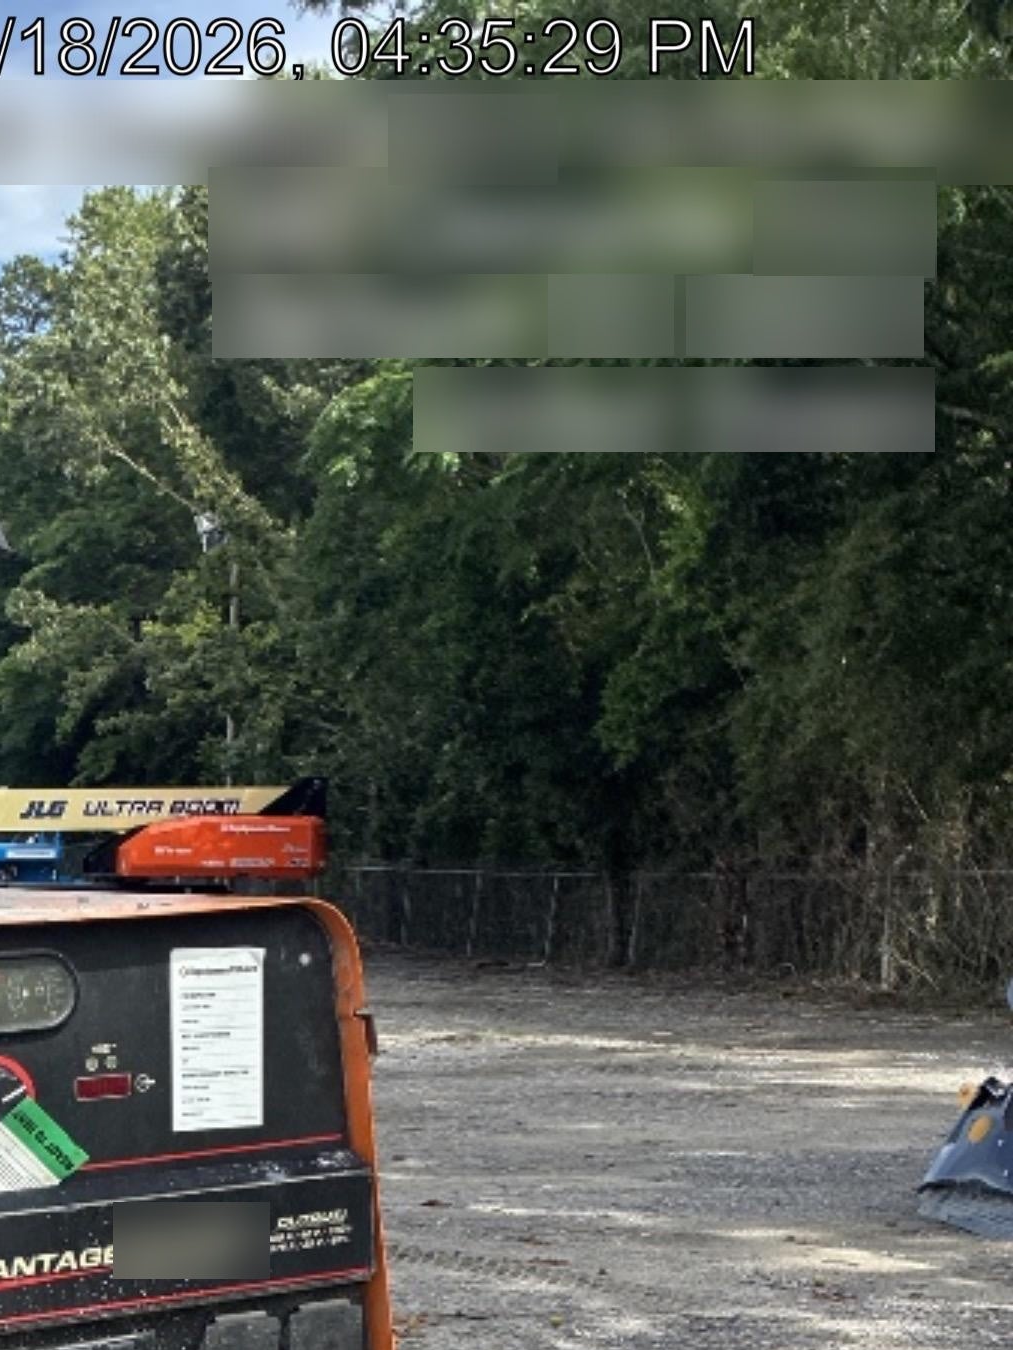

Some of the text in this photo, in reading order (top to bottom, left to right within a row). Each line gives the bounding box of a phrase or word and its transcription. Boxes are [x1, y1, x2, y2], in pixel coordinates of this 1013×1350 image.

[20, 799, 242, 820] JLG ULTRA BOOM
